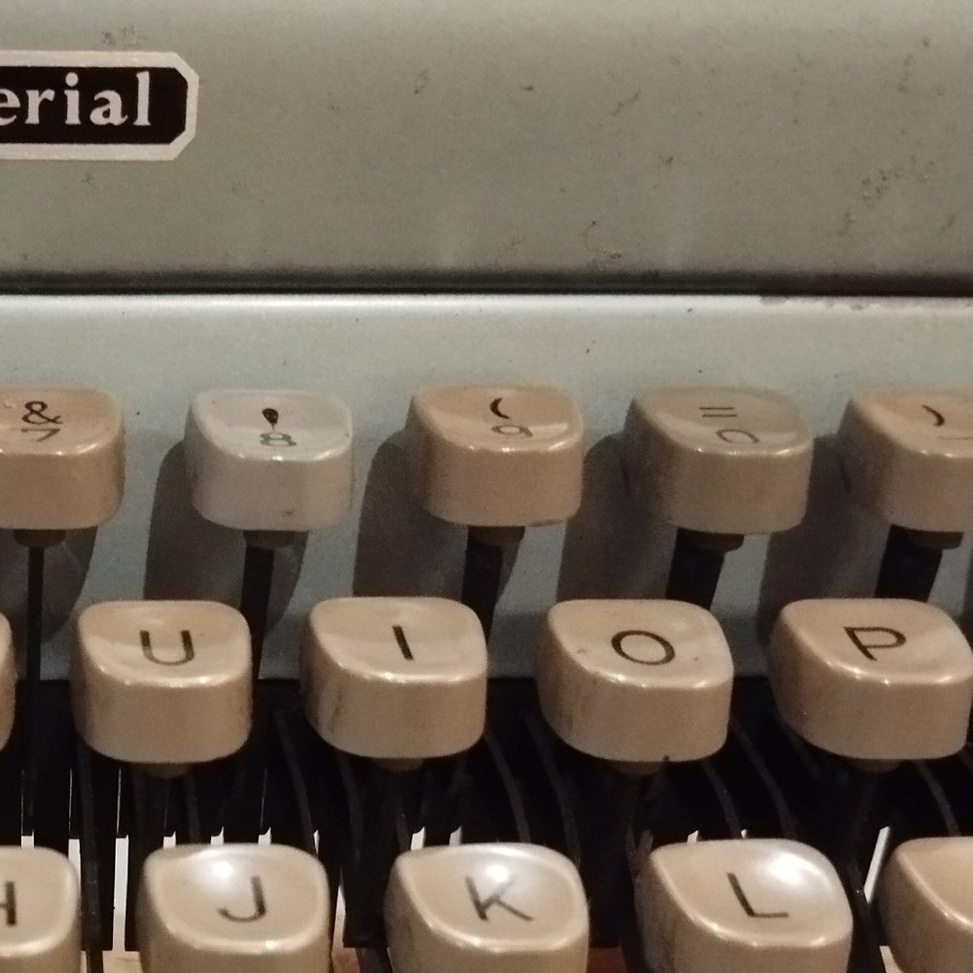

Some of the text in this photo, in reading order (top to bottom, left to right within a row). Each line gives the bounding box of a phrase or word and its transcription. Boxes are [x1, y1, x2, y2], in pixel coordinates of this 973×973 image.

[21, 400, 63, 425] &
[20, 427, 61, 442] 7
[259, 432, 297, 448] 8
[491, 424, 533, 438] 9
[139, 629, 195, 666] U
[392, 625, 415, 661] I
[611, 629, 676, 666] O
[843, 626, 907, 662] P
[218, 875, 267, 923] J
[465, 875, 534, 922] K
[727, 872, 789, 919] L
